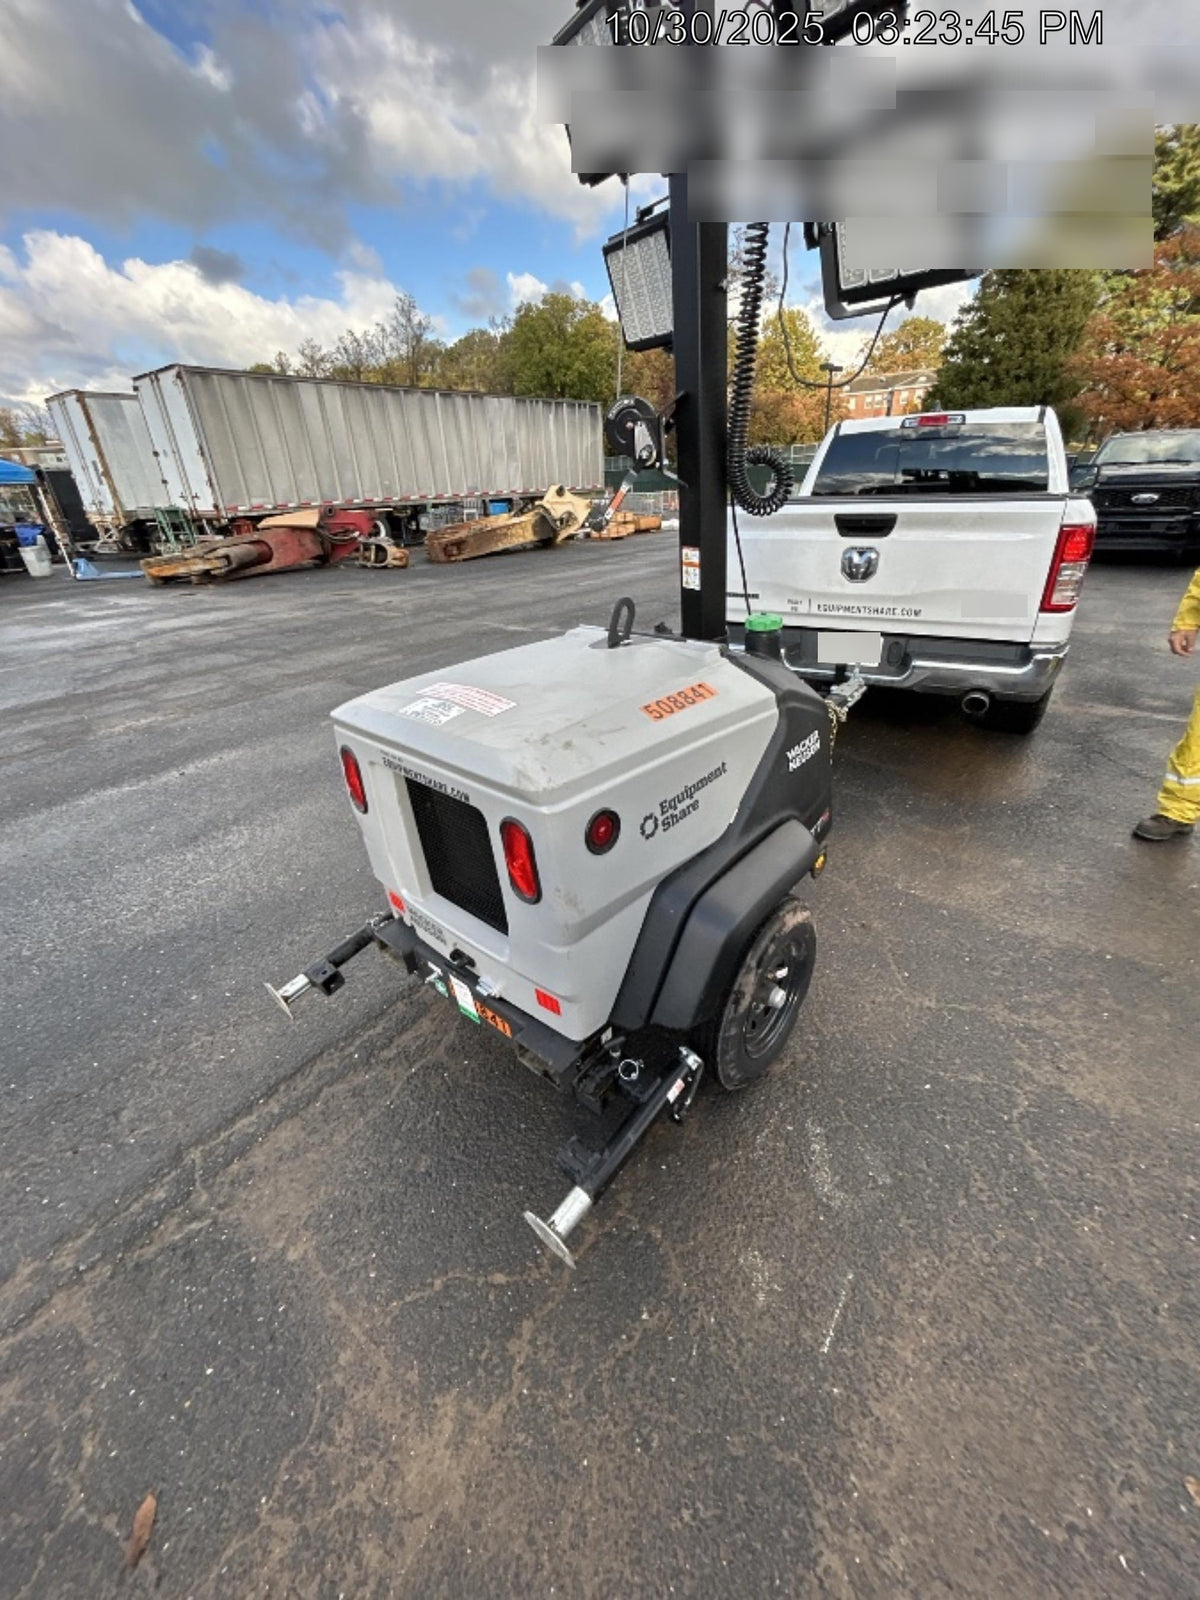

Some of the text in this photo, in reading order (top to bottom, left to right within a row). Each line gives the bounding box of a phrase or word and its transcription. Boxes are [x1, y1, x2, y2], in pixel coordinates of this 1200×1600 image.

[816, 603, 922, 617] EQUIPMENTSHARE.COM
[643, 683, 715, 720] 508841
[785, 730, 820, 761] WACKER
[788, 738, 821, 773] NEUSON
[658, 761, 728, 817] Equipment
[661, 799, 700, 833] Share
